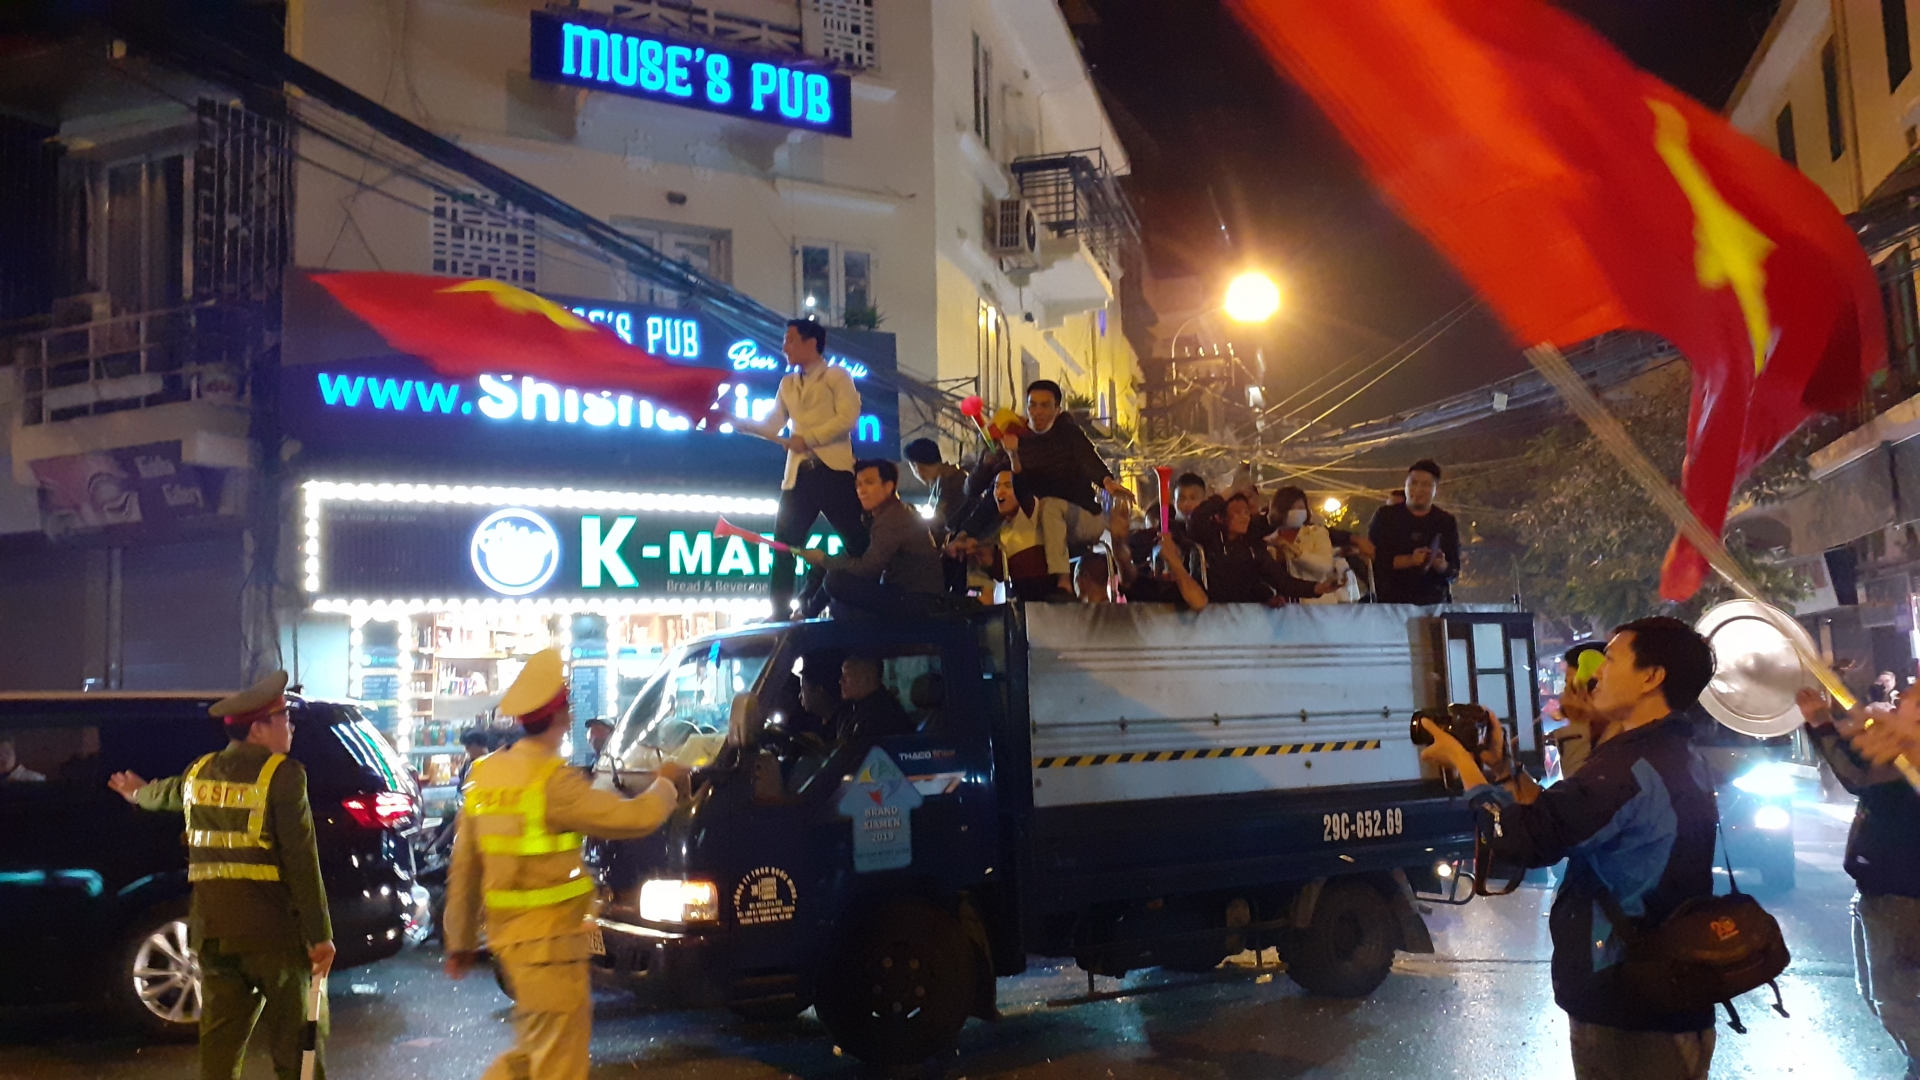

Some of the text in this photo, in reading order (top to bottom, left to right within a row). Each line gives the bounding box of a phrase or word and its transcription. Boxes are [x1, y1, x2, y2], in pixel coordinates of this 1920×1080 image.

[562, 23, 831, 123] MUSE'S PUB
[646, 306, 700, 358] PUB
[666, 580, 769, 595] Bread & Beverage
[864, 806, 899, 818] BRAND
[1323, 807, 1403, 842] 29C-652.69
[863, 819, 901, 831] XIAMEN
